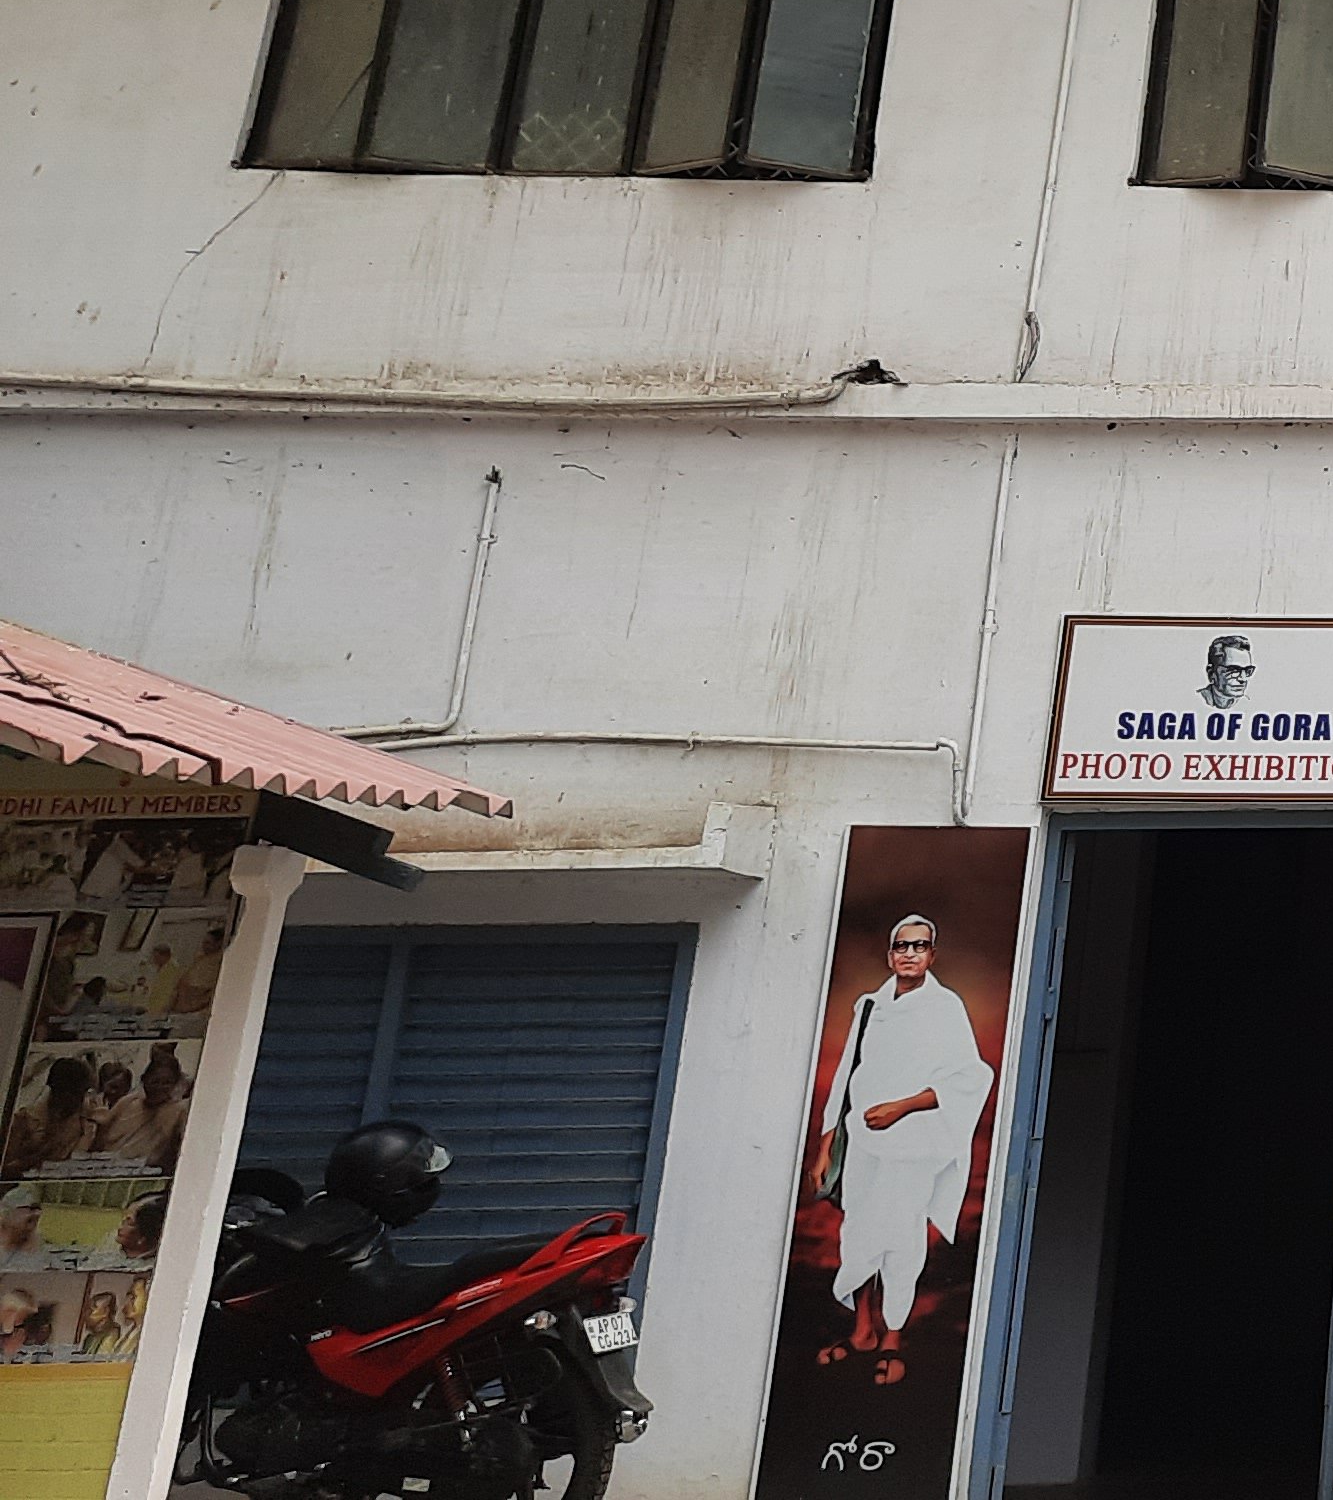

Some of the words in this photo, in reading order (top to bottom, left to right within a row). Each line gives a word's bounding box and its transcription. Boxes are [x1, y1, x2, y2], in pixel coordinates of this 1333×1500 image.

[1117, 711, 1196, 740] SAGA
[1206, 713, 1242, 741] OF
[1250, 713, 1331, 741] GORA
[1059, 753, 1172, 780] PHOTO
[50, 796, 136, 815] FAMILY
[140, 794, 244, 814] MEMBERS
[820, 1434, 896, 1471] గోరా
